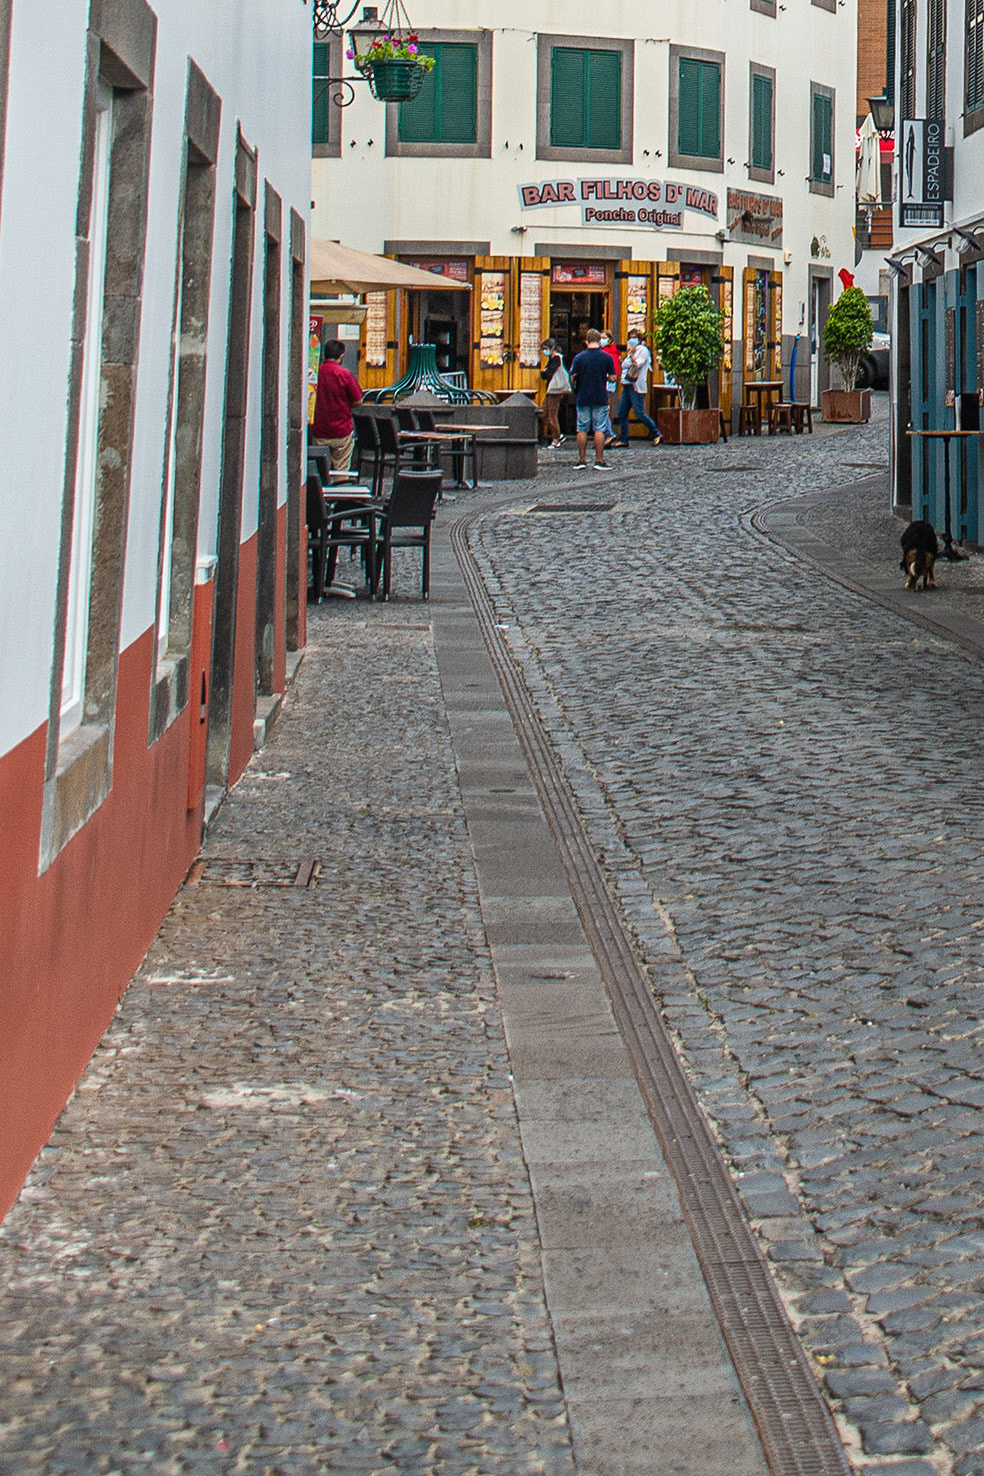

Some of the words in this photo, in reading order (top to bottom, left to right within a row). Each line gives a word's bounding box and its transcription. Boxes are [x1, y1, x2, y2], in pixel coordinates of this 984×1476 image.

[927, 123, 940, 200] ESPADEIRO
[521, 181, 576, 206] BAR
[581, 180, 661, 202] FILHOS
[686, 187, 718, 217] MAR
[585, 207, 636, 222] Poncha
[638, 208, 682, 226] Original
